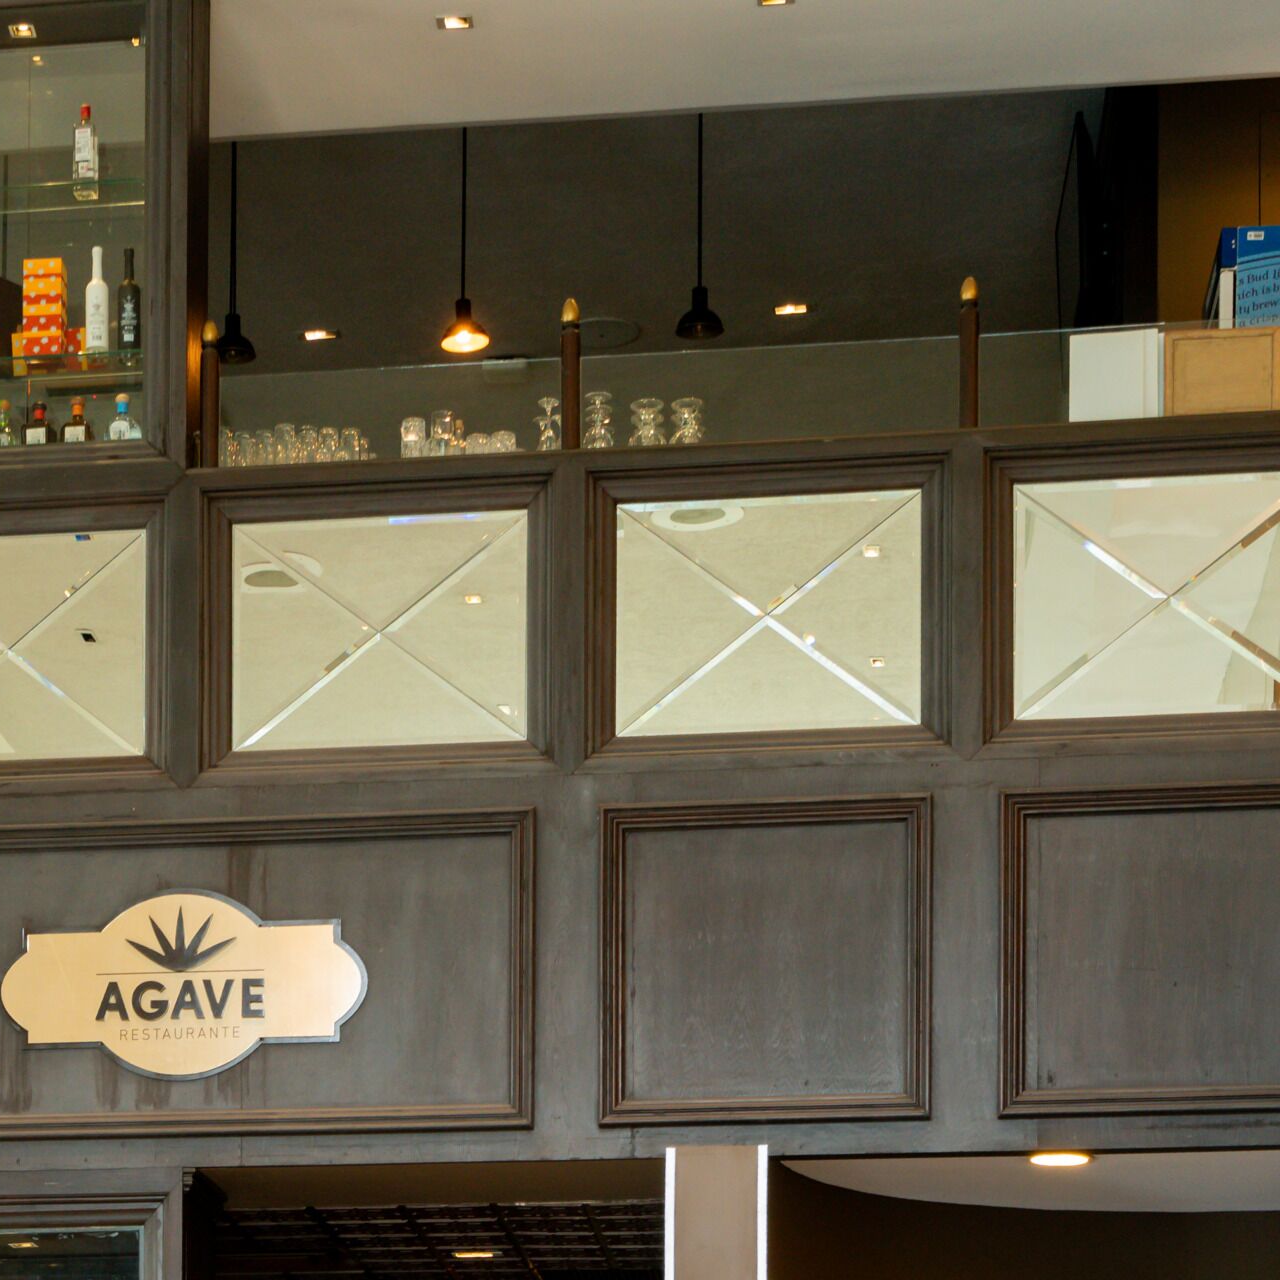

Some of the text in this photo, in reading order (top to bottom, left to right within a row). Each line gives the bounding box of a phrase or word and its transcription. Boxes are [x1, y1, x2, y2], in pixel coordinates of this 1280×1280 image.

[1247, 270, 1269, 284] Bud
[95, 978, 265, 1021] AGAVE
[119, 1026, 241, 1041] RESTAURANTE
